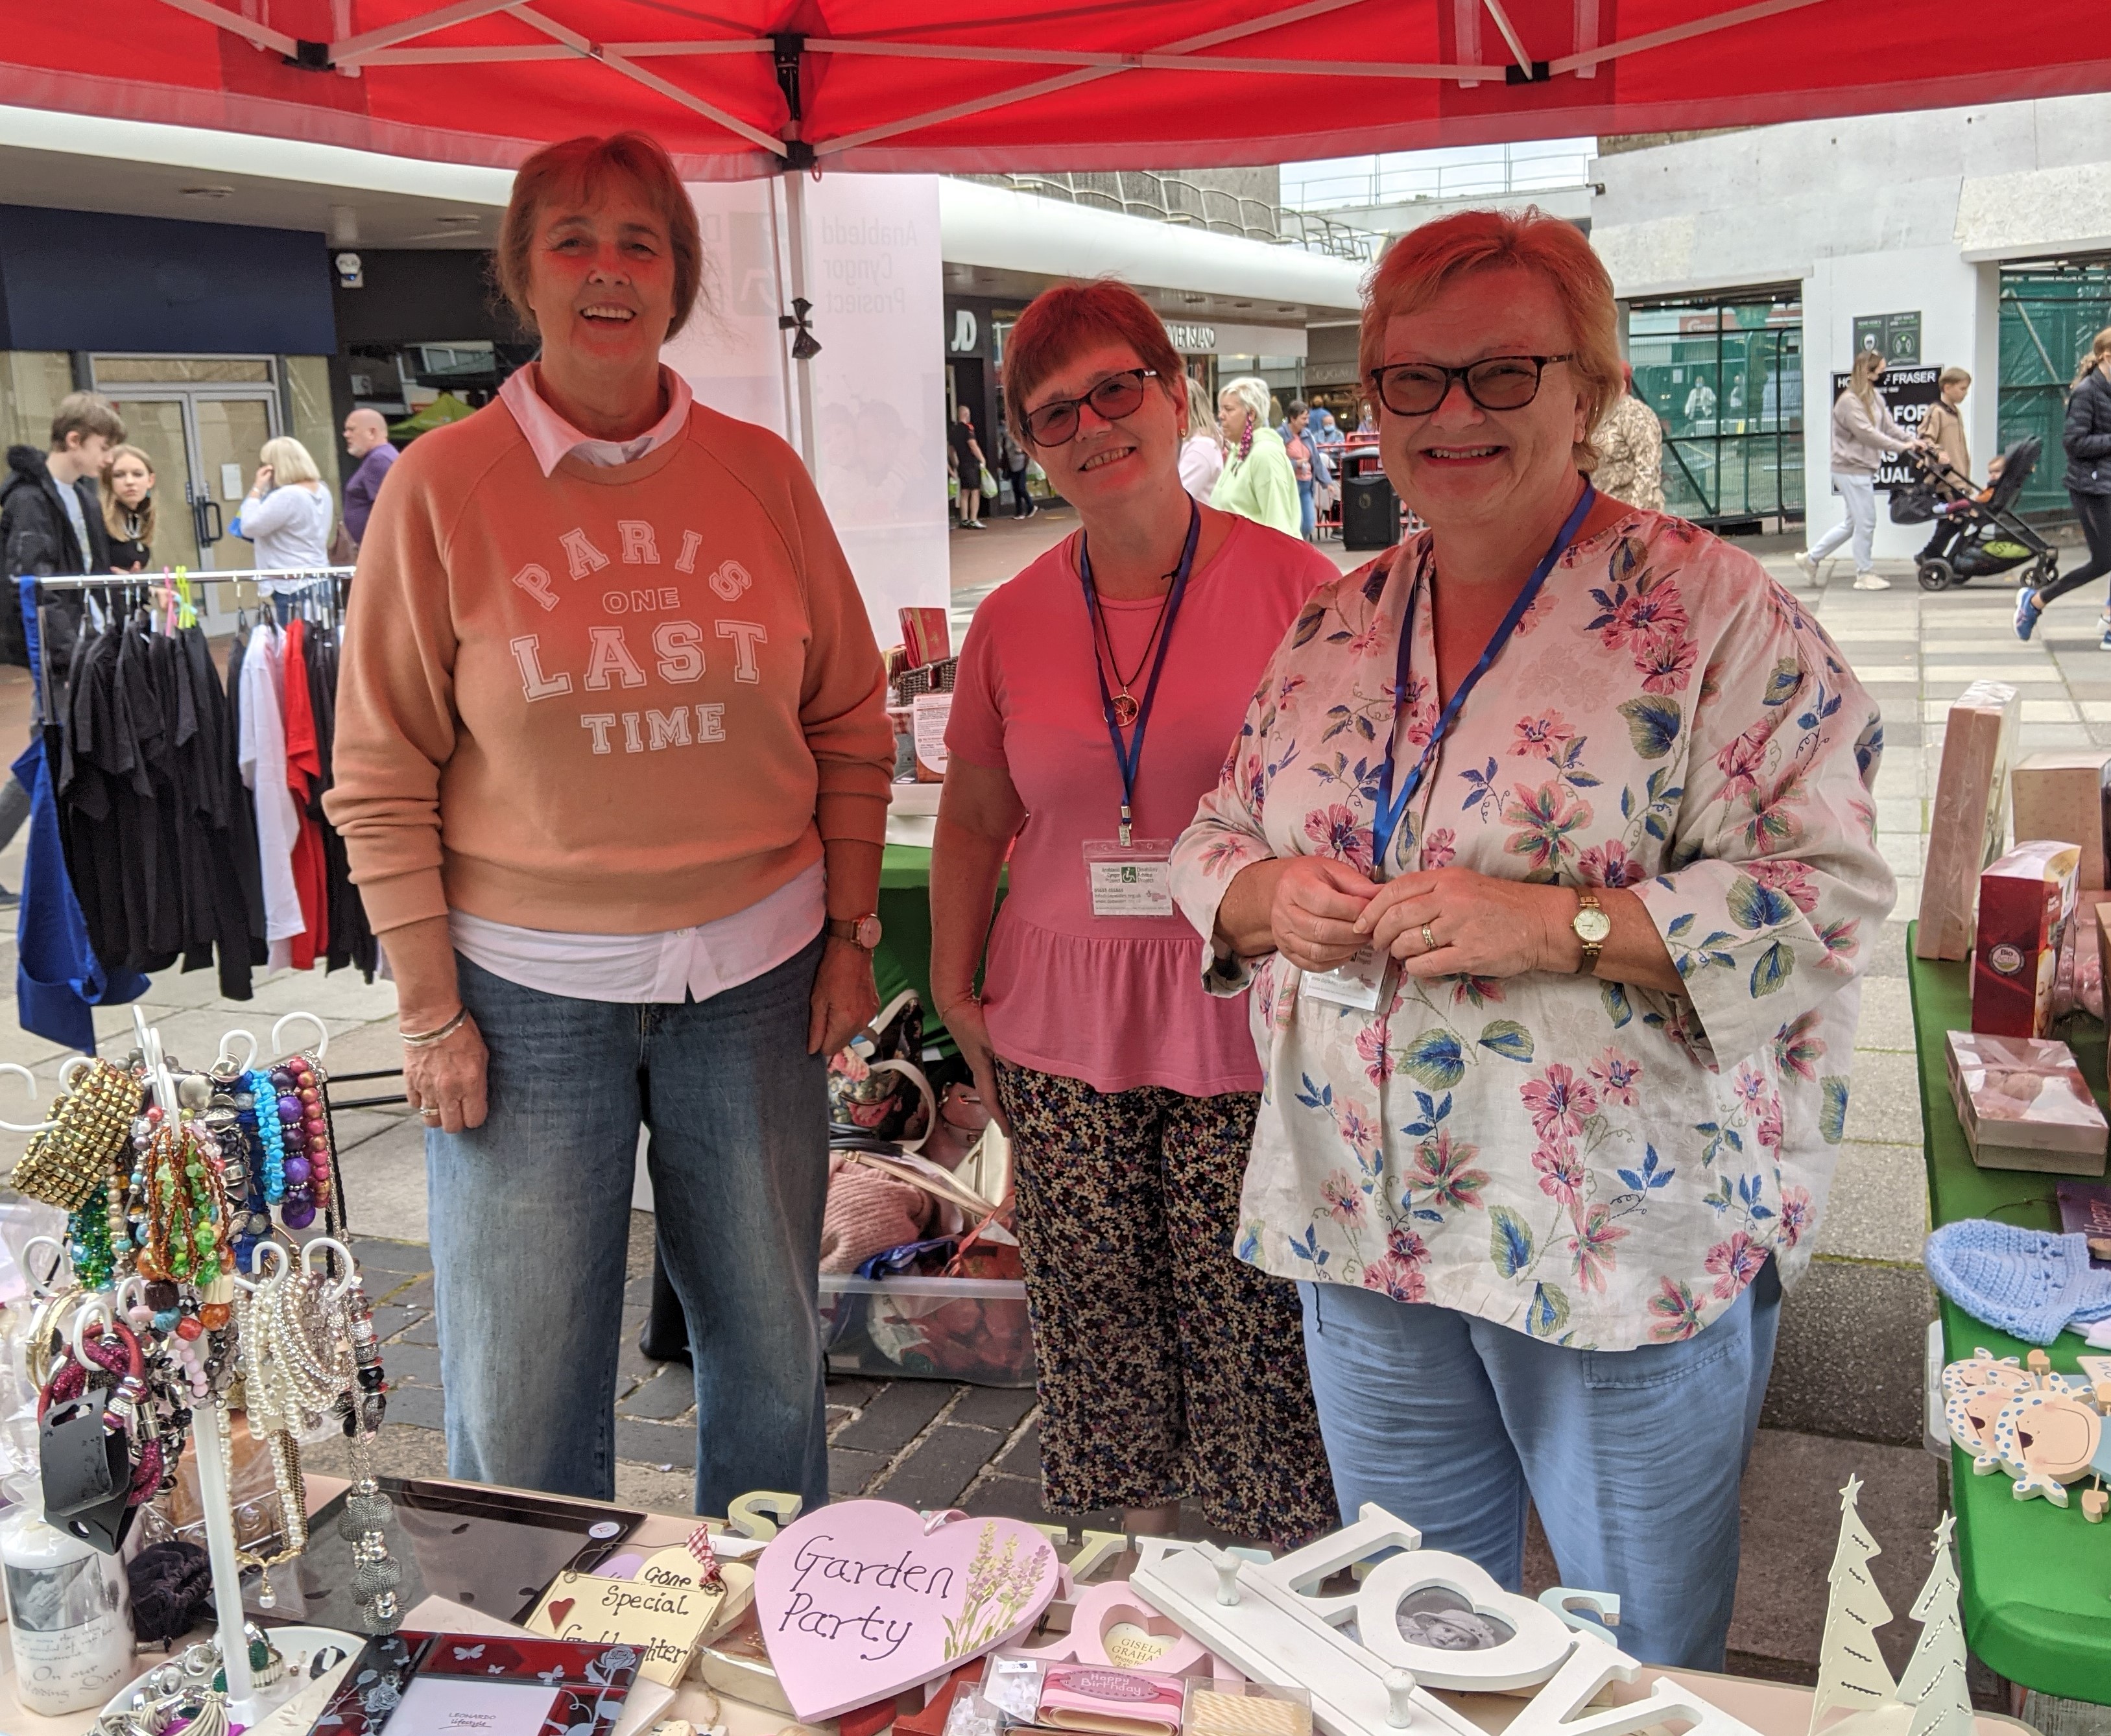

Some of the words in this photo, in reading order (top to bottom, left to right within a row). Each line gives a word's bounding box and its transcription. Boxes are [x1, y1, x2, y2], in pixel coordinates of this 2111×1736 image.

[951, 310, 977, 351] JD
[1892, 370, 1937, 385] FRASER
[512, 519, 752, 612] PARIS
[602, 587, 681, 614] ONE
[510, 619, 769, 703] LAST
[580, 702, 726, 755] TIME
[644, 1566, 692, 1587] Gone
[789, 1534, 954, 1599] Garden
[602, 1585, 689, 1617] Special
[778, 1591, 914, 1661] Party
[1112, 1645, 1157, 1662] GRAHA
[1115, 1655, 1133, 1665] Photo
[1121, 1638, 1162, 1656] GISELA
[1080, 1678, 1141, 1696] Birthday
[1090, 1672, 1130, 1686] Happy
